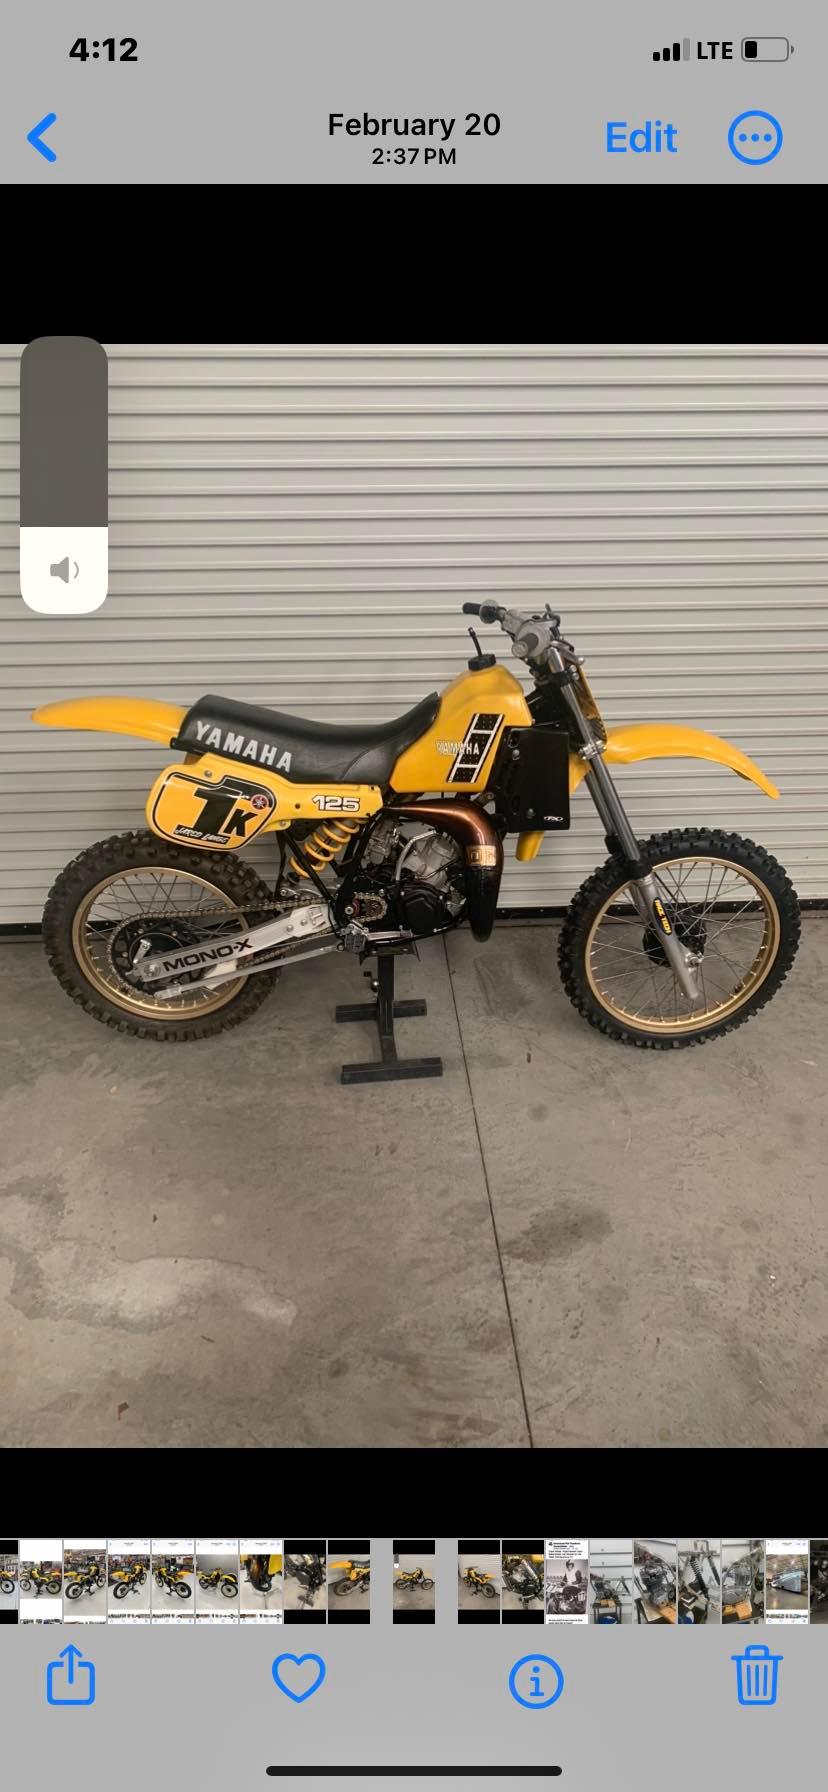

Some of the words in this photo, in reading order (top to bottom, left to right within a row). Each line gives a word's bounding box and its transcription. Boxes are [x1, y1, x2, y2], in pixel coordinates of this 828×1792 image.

[196, 722, 292, 773] YAMAHA
[436, 741, 479, 755] YAMAHA
[312, 796, 360, 812] 125
[162, 939, 253, 972] MONO-X
